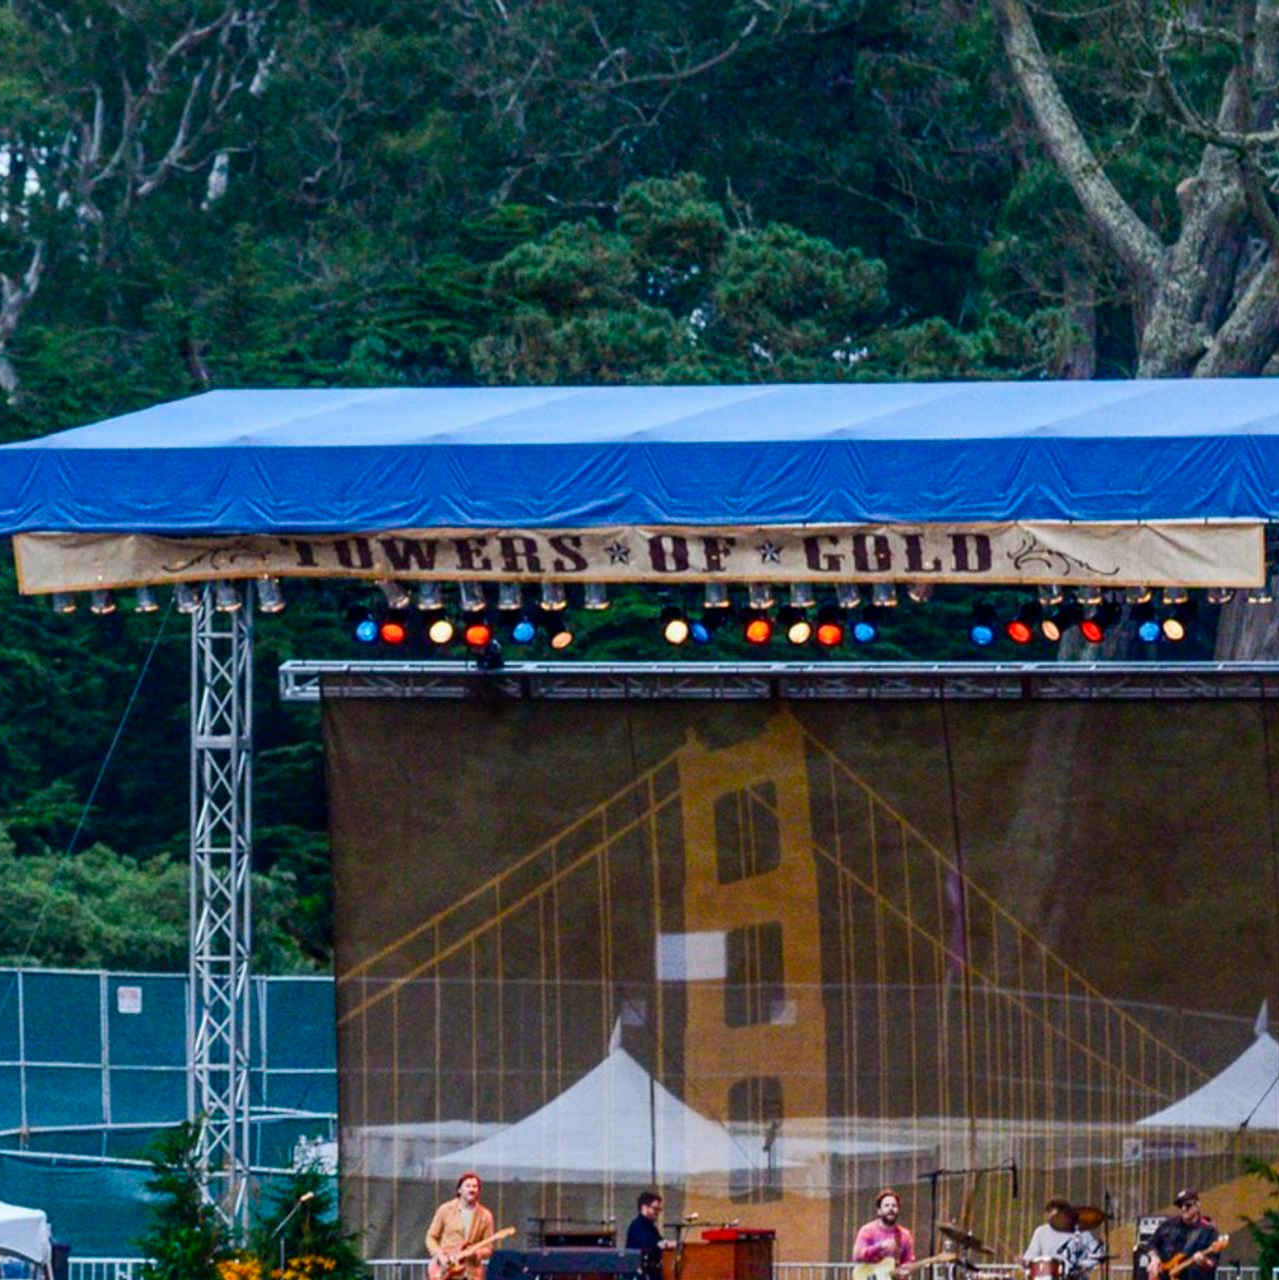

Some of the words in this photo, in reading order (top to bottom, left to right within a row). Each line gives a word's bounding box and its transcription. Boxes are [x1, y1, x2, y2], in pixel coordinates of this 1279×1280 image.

[279, 536, 588, 573] TOWERS
[648, 535, 735, 573] OF
[802, 533, 993, 573] GOLD
